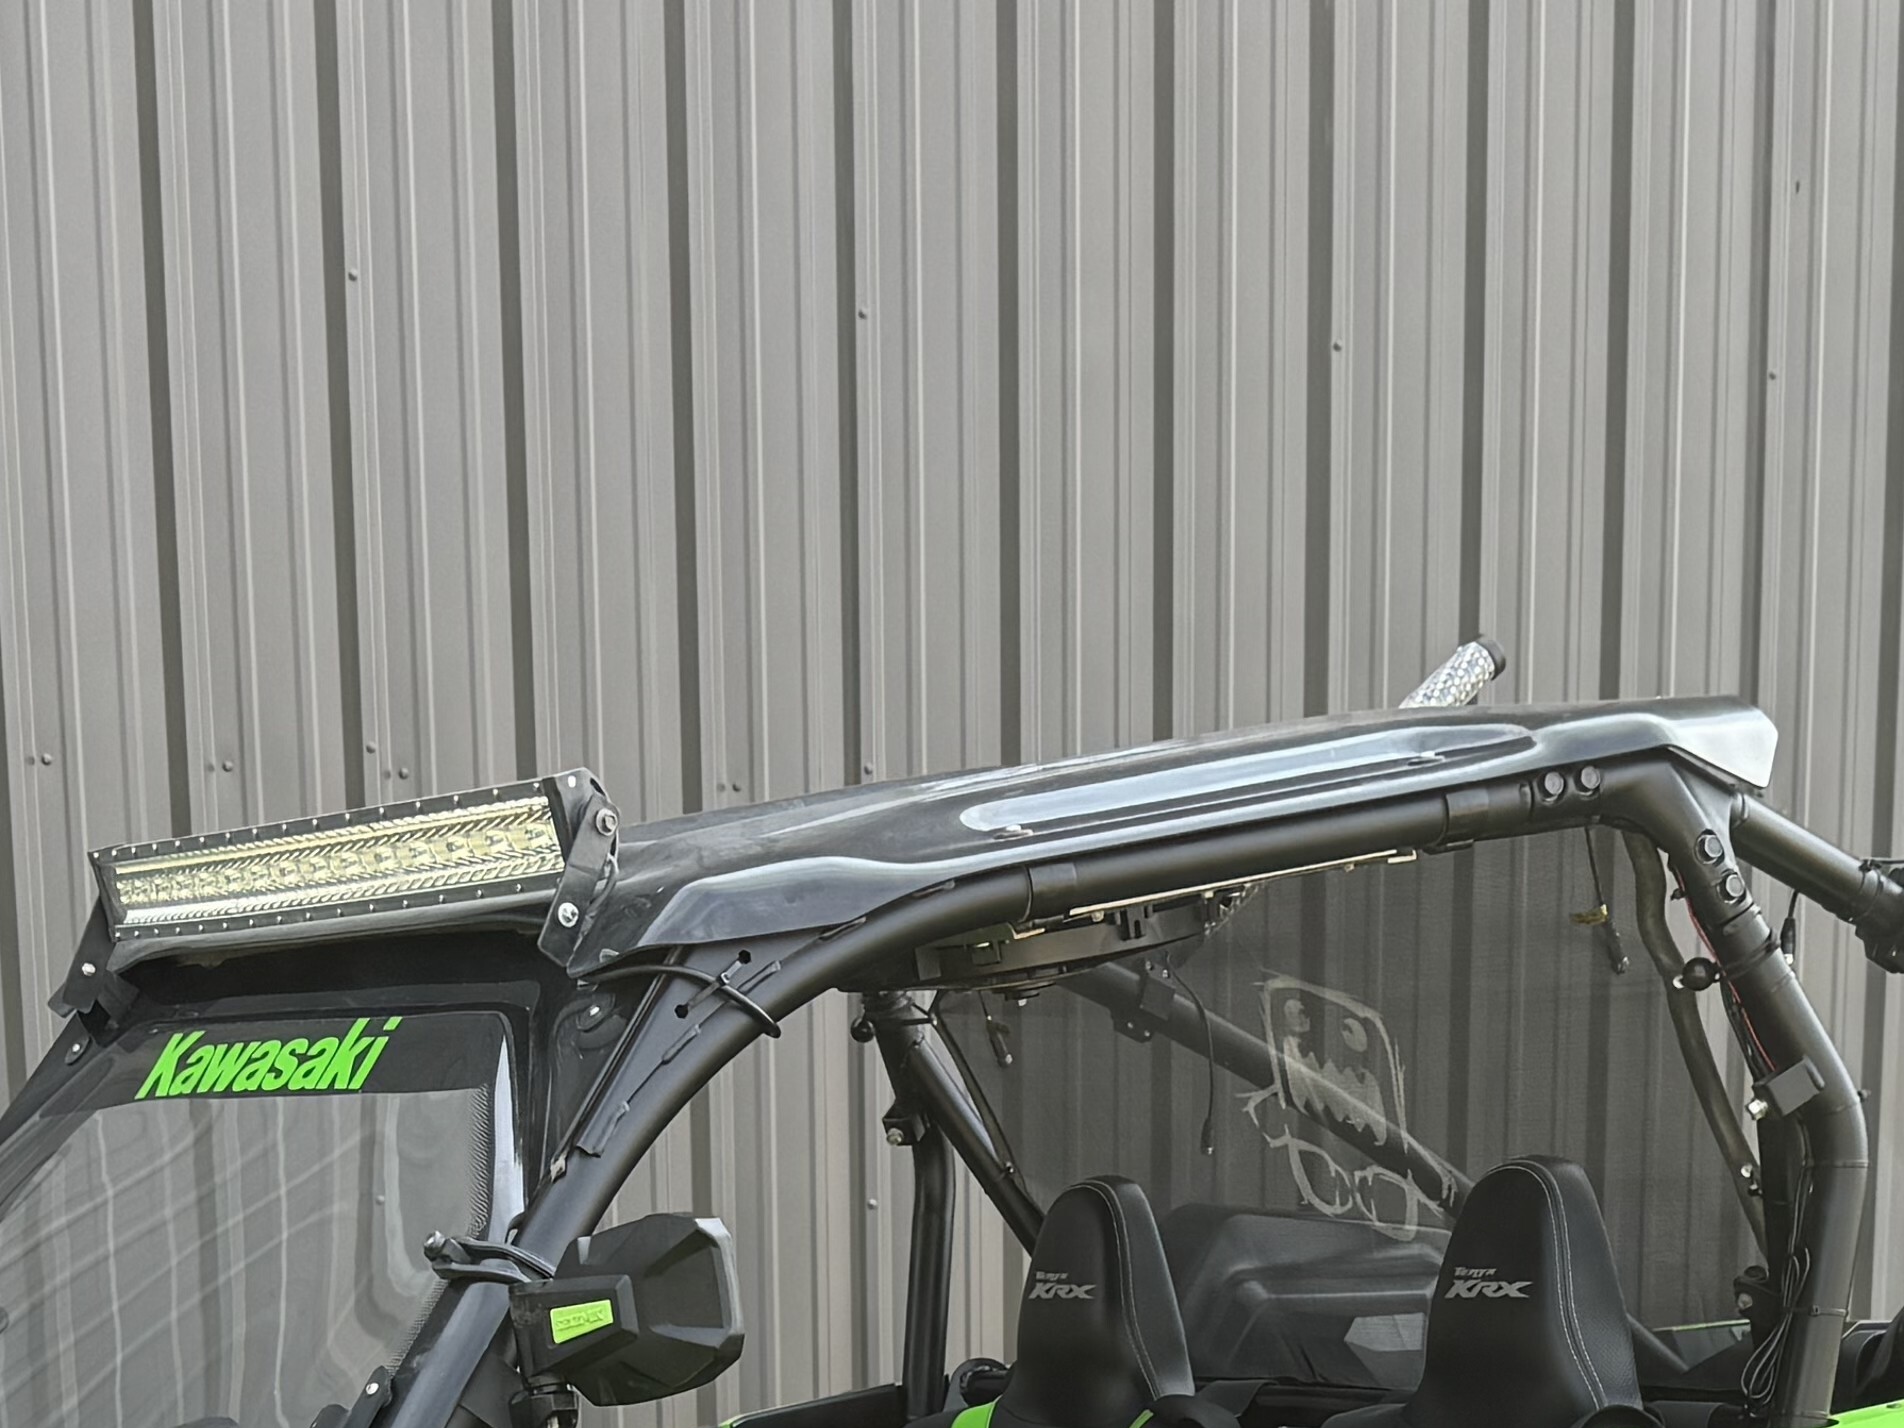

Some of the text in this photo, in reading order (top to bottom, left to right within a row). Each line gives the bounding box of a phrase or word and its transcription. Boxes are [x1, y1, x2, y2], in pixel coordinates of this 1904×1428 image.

[135, 1016, 402, 1100] Kawasaki
[1028, 1282, 1097, 1300] KRX
[1444, 1279, 1533, 1299] KRX
